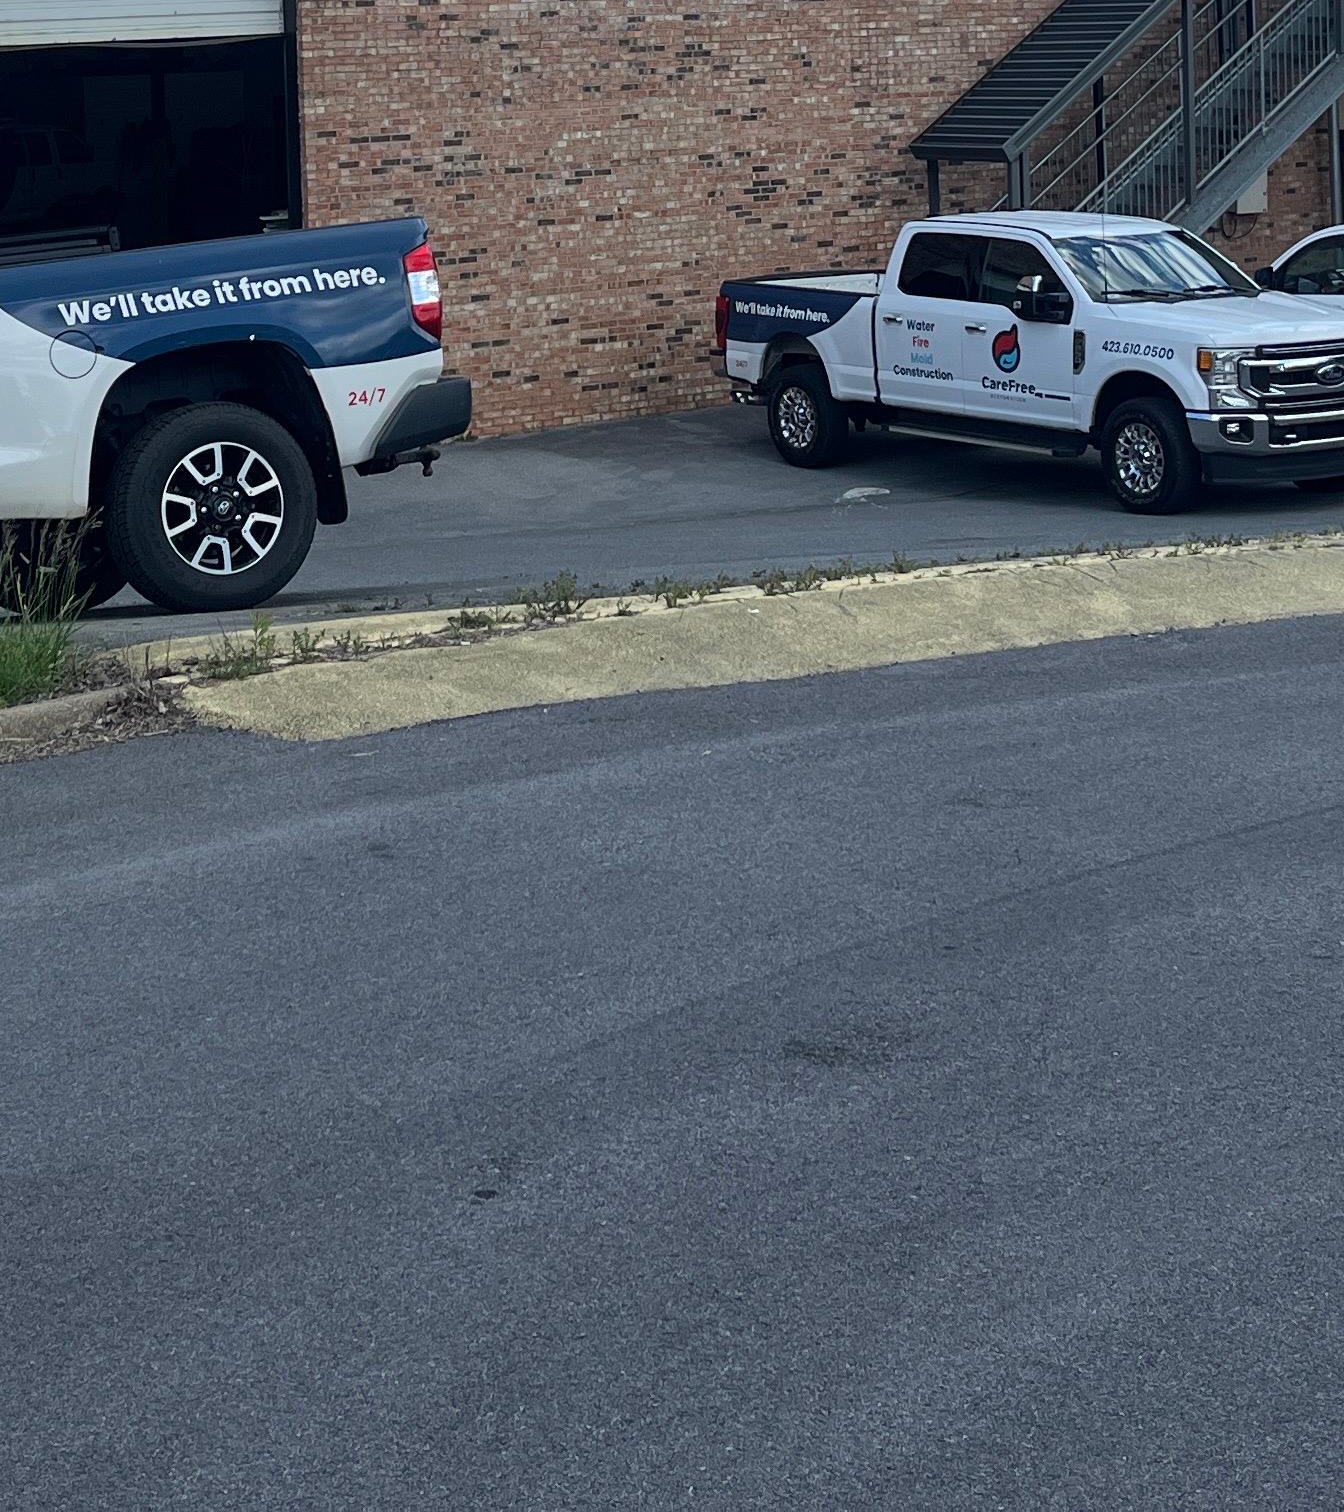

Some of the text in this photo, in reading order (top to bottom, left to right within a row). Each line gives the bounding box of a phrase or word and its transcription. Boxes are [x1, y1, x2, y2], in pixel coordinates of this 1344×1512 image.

[57, 265, 386, 326] We'll take it from here.
[735, 300, 831, 323] We'll take it from here.
[906, 319, 935, 332] Water
[912, 335, 929, 348] Fire
[1101, 340, 1175, 360] 423.610.0500
[910, 352, 933, 365] Mold
[893, 364, 954, 381] Construction
[981, 376, 1036, 394] CareFree
[348, 388, 387, 407] 24/7
